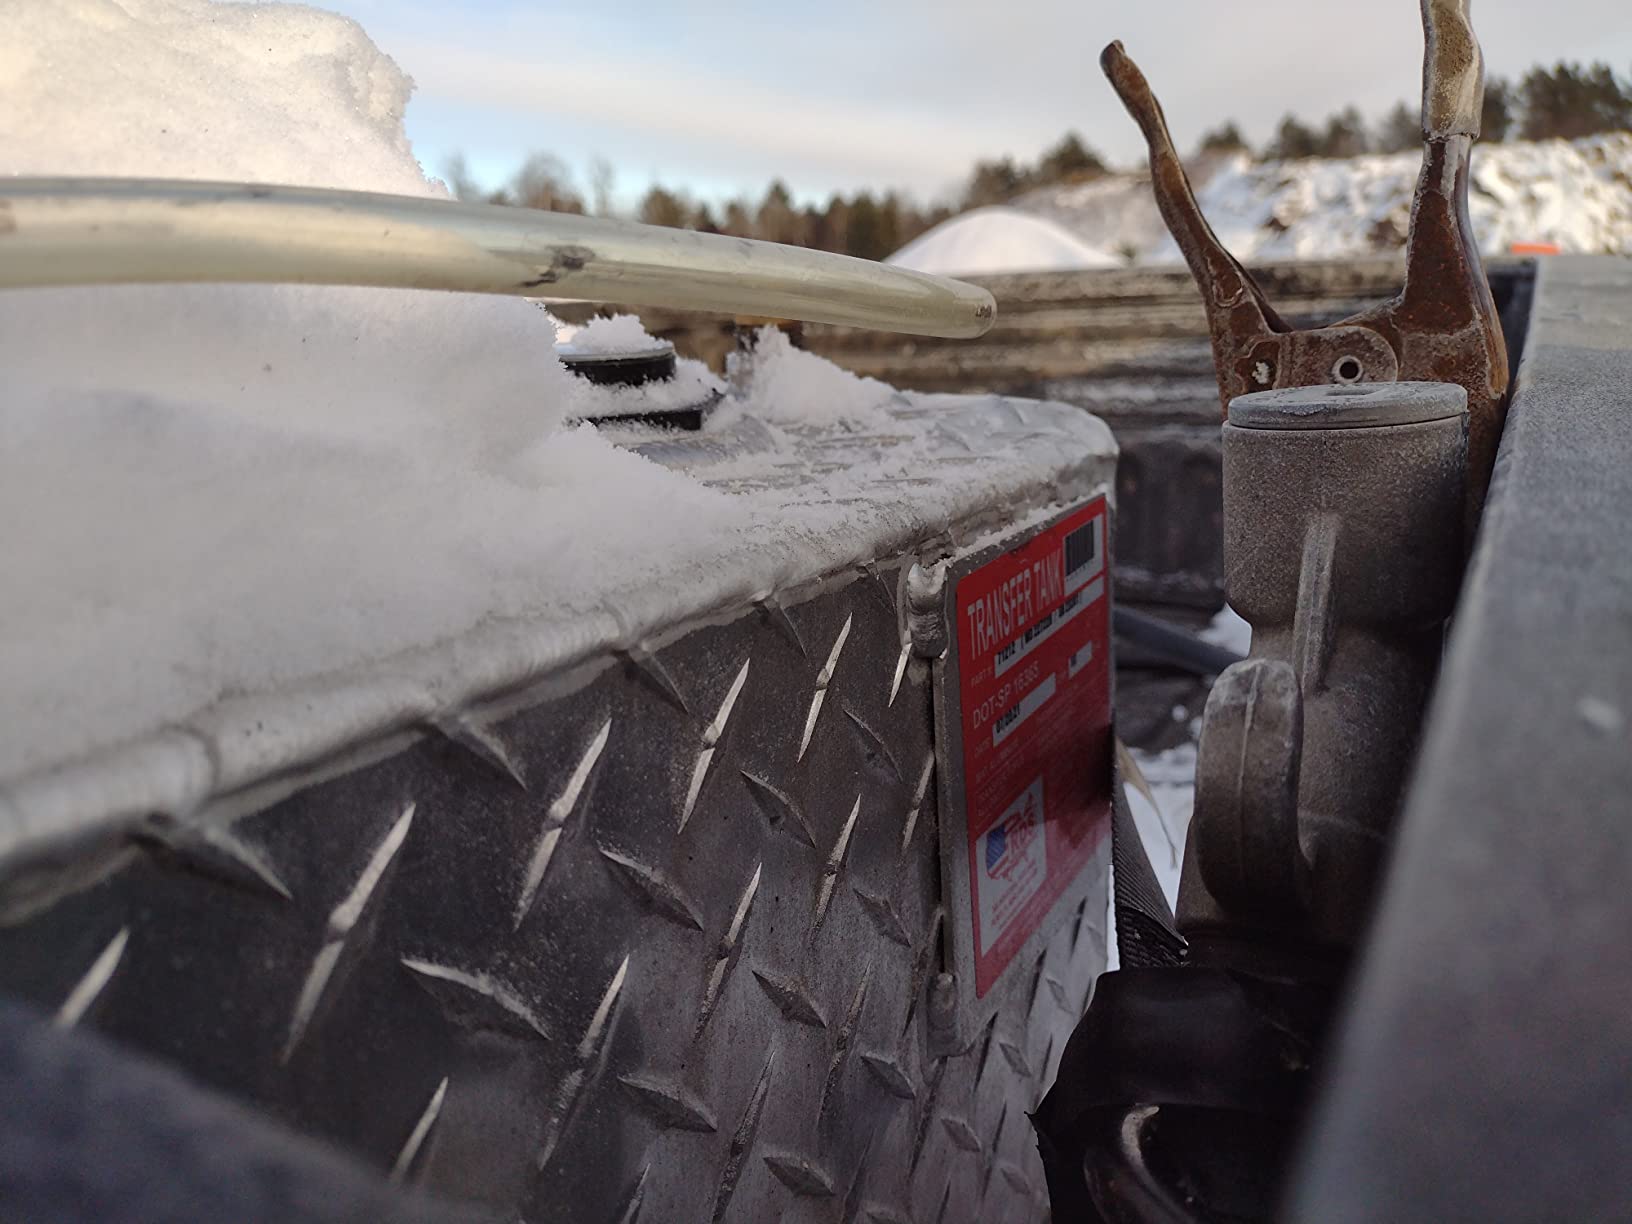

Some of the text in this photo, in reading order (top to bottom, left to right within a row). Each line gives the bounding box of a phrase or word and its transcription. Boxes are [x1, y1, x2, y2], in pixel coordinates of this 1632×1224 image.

[967, 567, 1033, 661] TRANSFER
[1033, 547, 1064, 616] TANK
[973, 682, 1012, 729] DOT-SP
